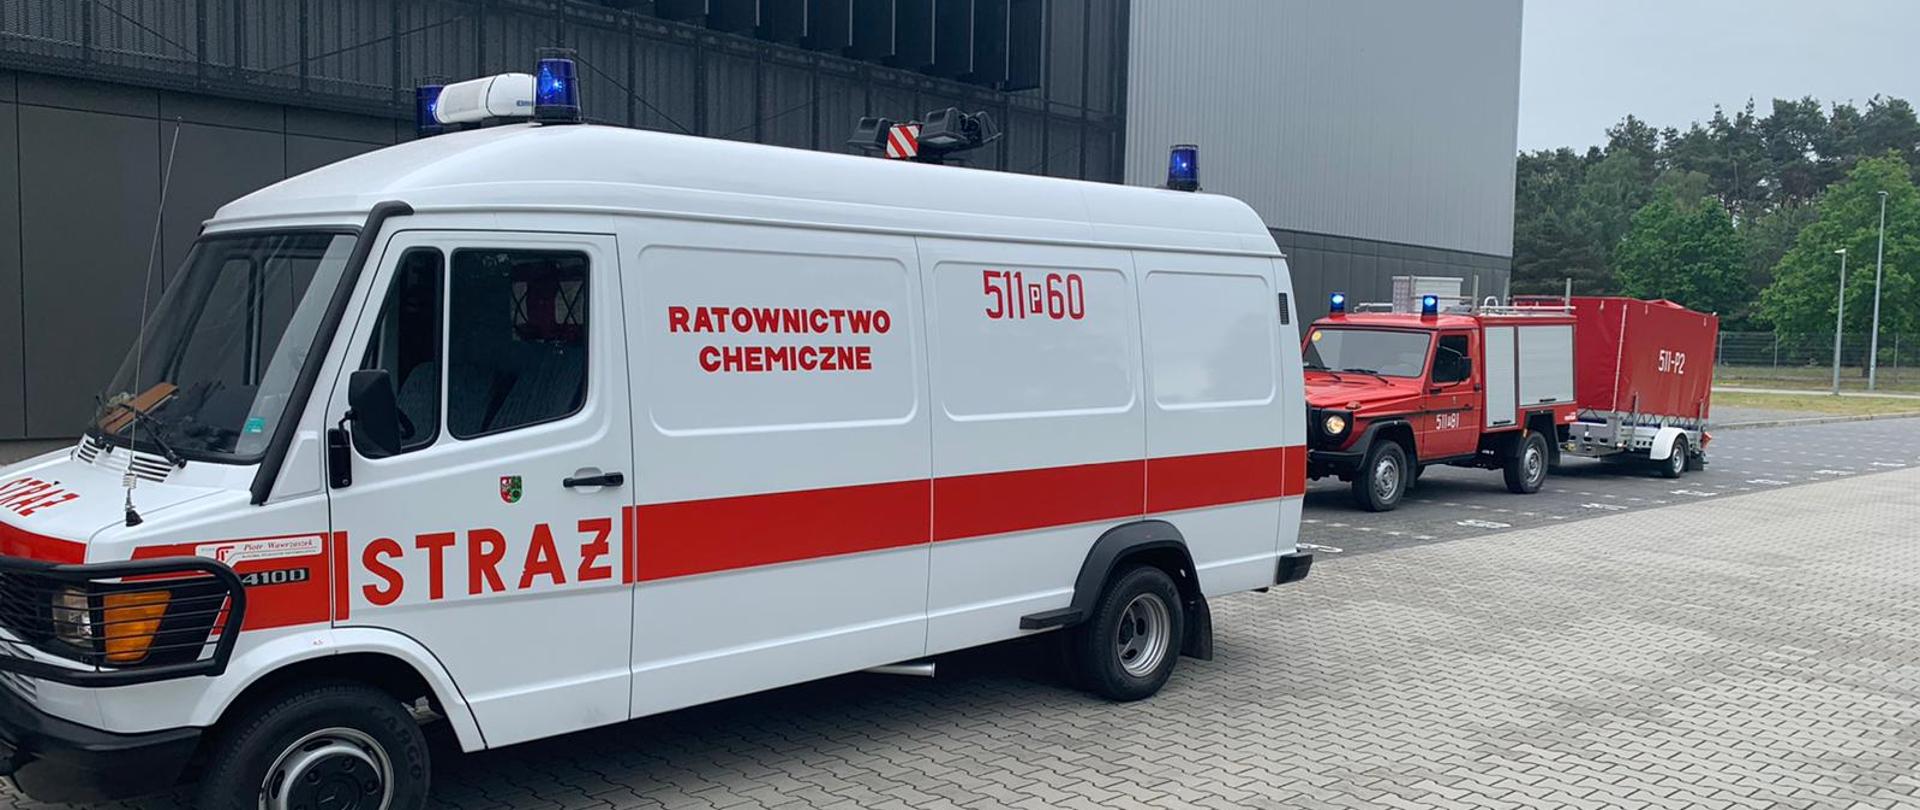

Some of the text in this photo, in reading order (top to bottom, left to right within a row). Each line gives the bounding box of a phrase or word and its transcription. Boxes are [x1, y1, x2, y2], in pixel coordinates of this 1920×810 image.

[668, 306, 891, 334] RATOWNICTWO
[699, 345, 872, 372] CHEMICZNE
[1658, 350, 1685, 374] 511-P2
[362, 517, 612, 606] STRAŻ
[242, 569, 306, 585] 410D
